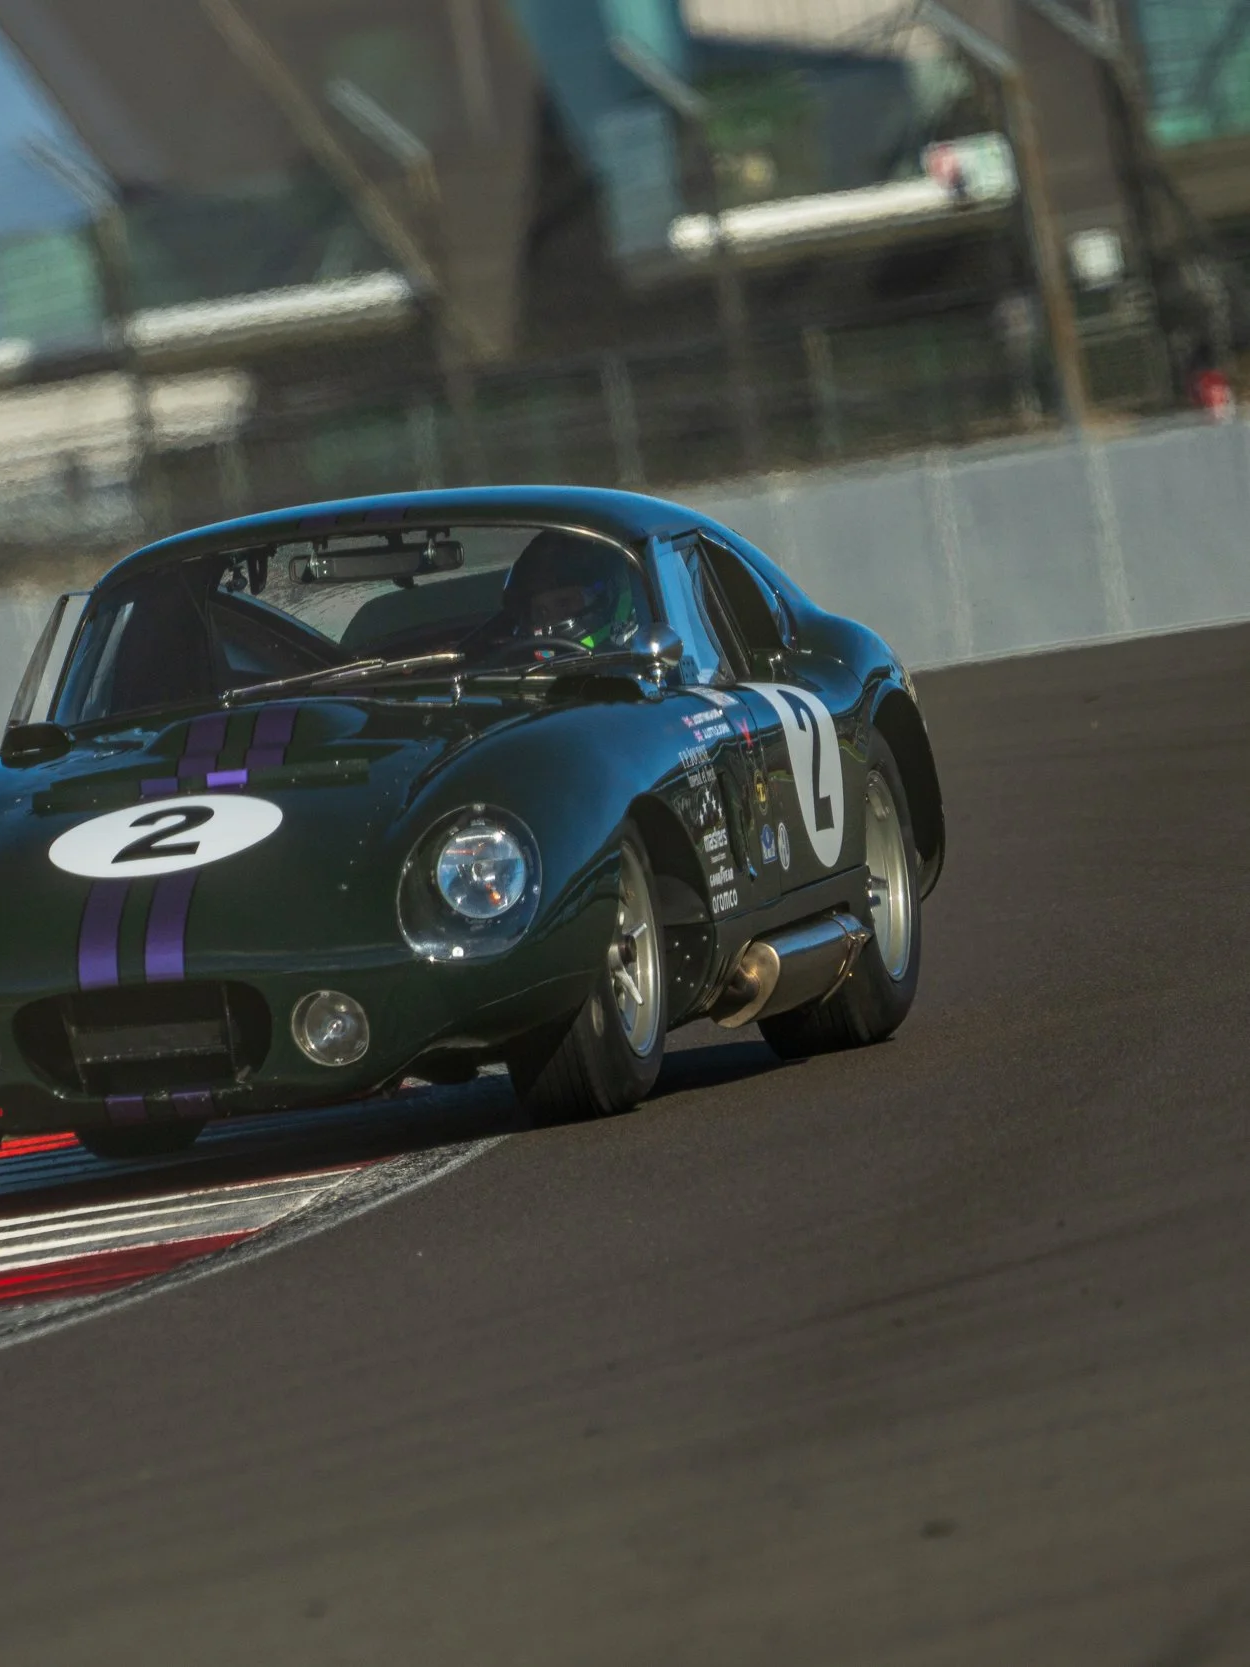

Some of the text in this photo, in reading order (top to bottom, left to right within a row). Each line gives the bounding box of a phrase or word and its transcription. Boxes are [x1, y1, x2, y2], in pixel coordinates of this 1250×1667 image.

[777, 689, 835, 832] 2
[111, 805, 214, 864] 2
[703, 827, 728, 852] masters
